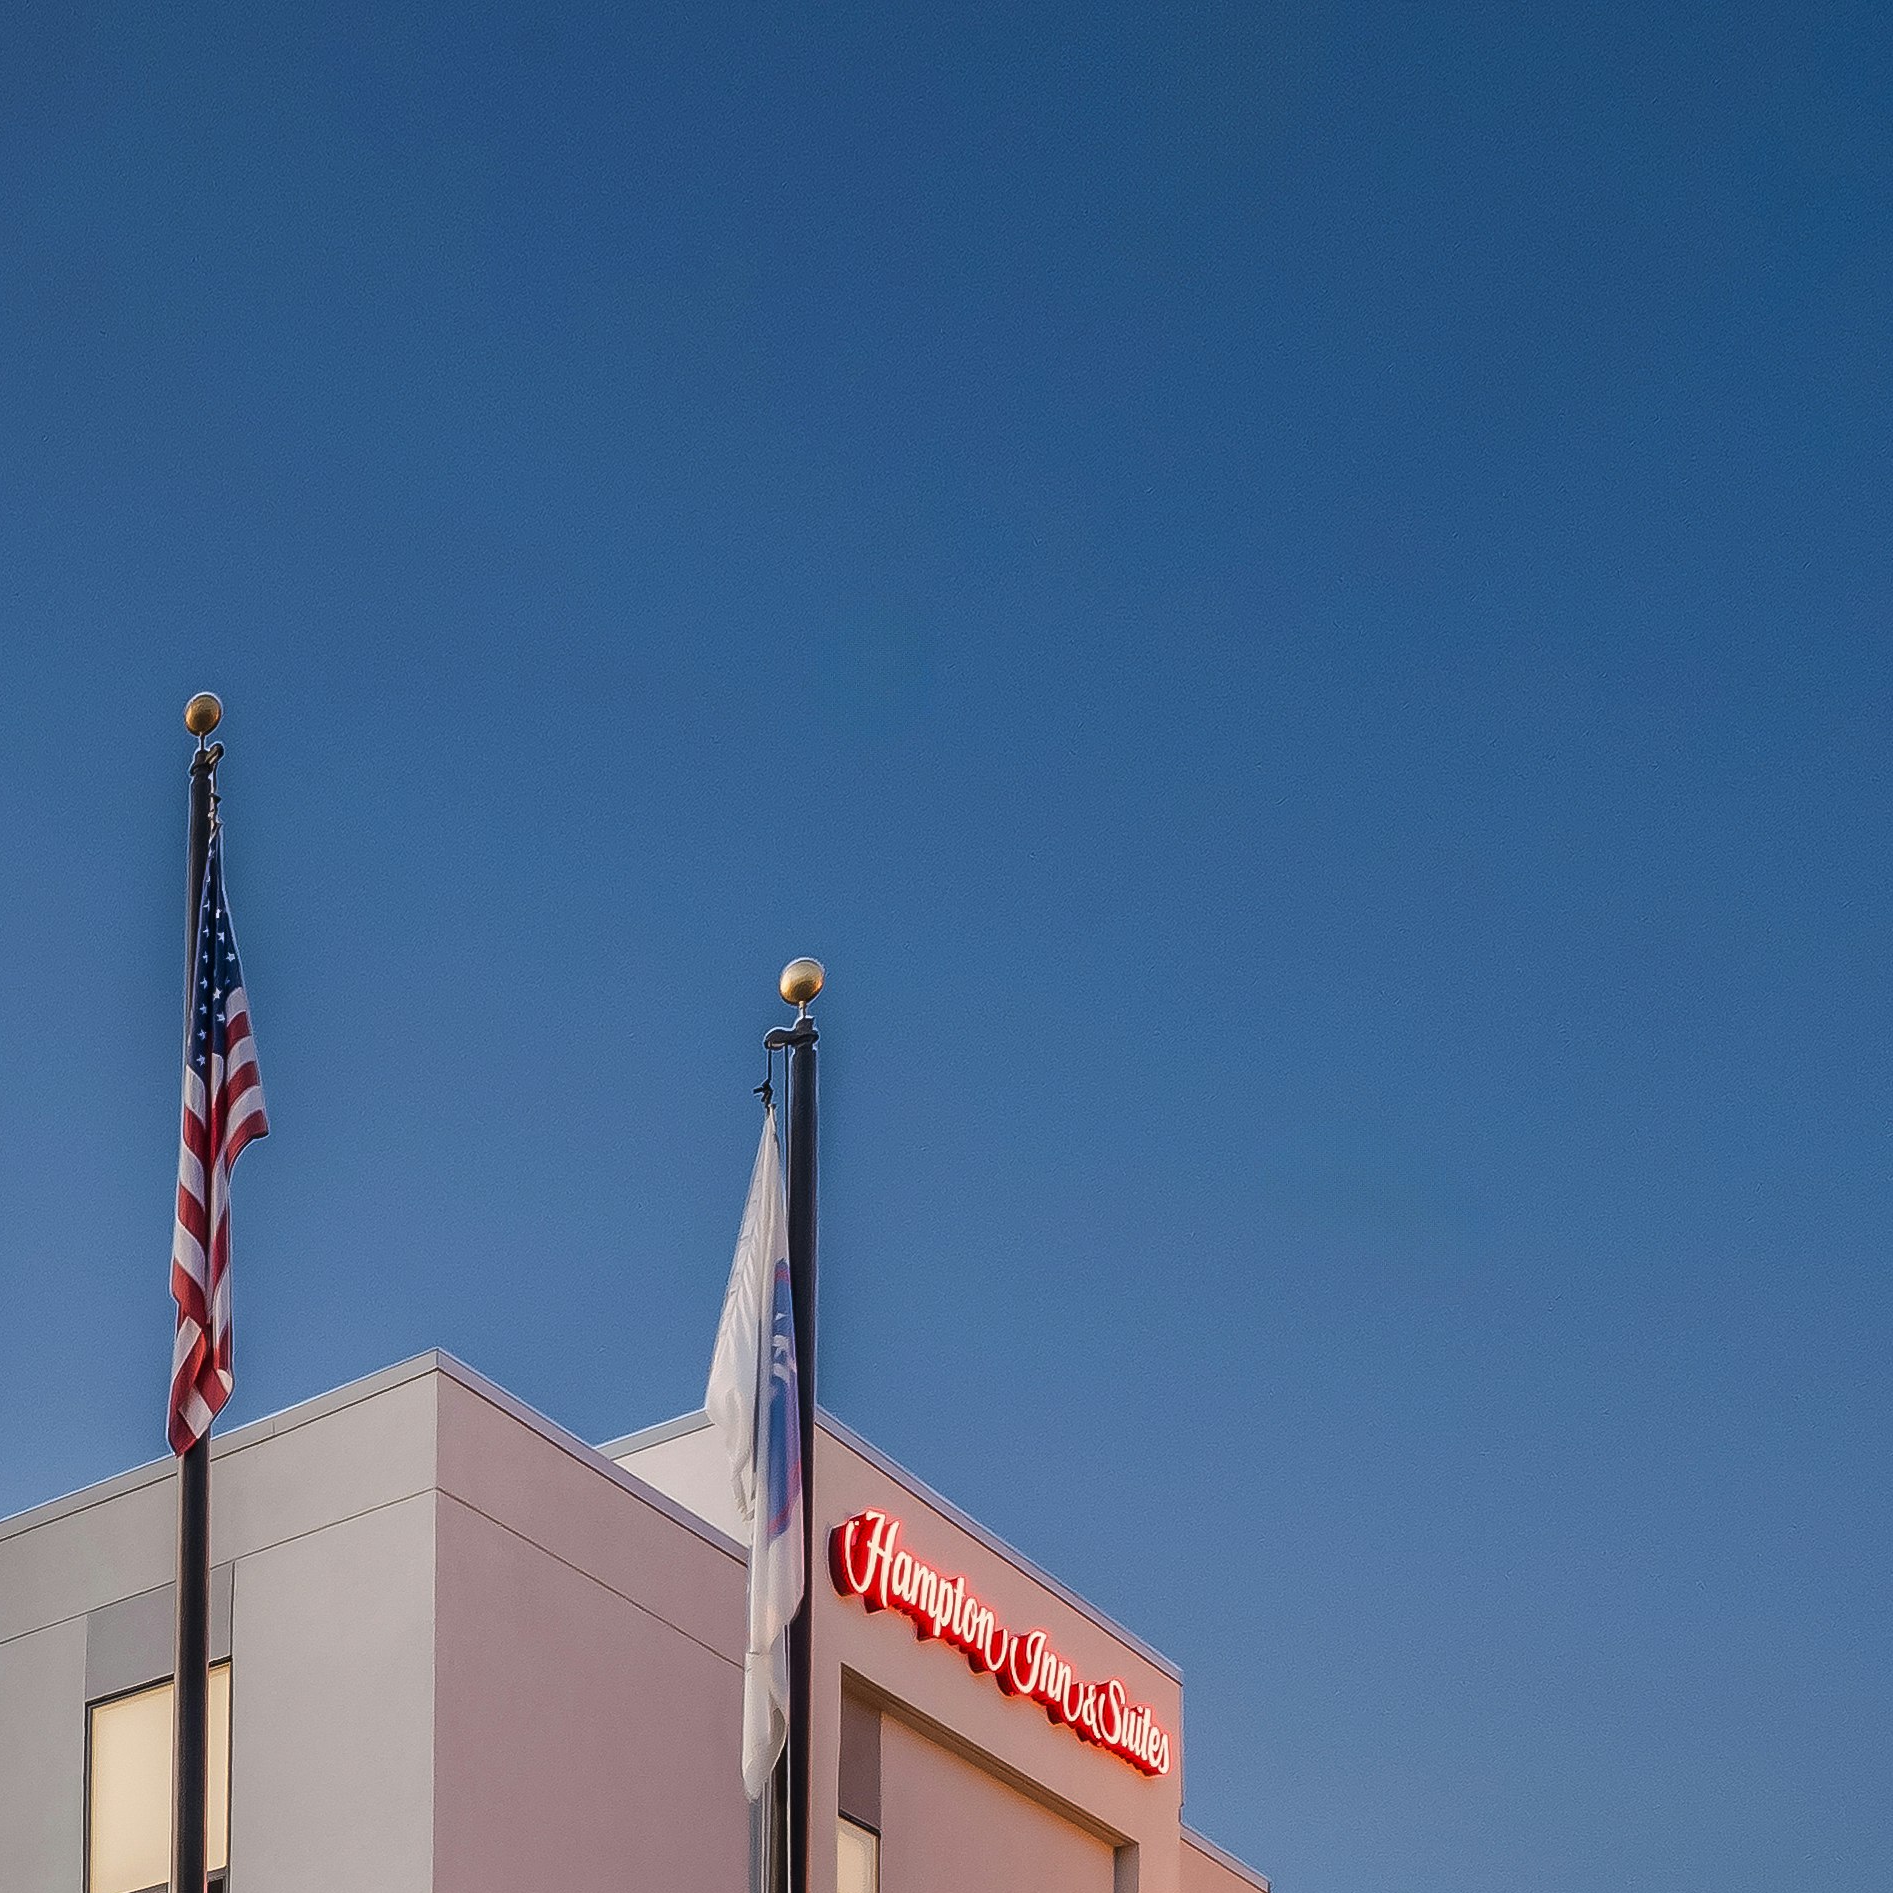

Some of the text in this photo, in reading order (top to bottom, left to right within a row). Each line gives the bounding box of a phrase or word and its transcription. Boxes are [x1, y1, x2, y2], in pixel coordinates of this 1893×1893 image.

[838, 1510, 1170, 1775] Hampton Inn & Suites
